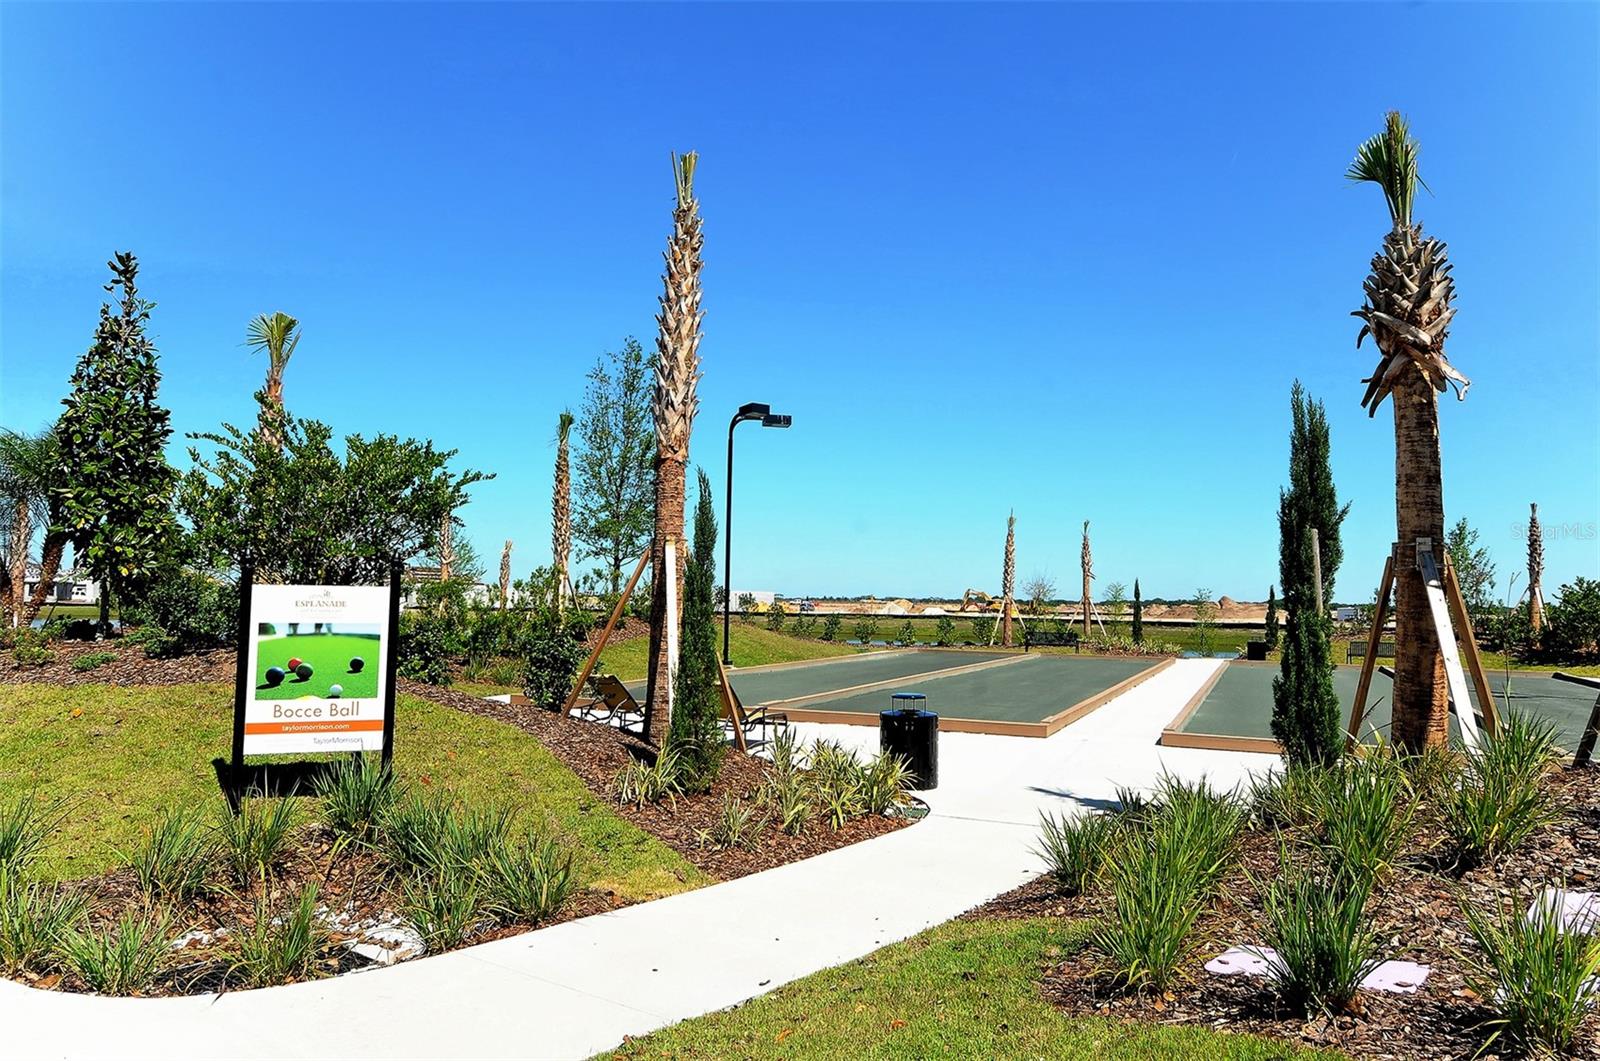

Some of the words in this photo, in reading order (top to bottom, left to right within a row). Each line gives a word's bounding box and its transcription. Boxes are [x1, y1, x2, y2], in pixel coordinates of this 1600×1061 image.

[295, 600, 347, 608] ESPLANADE
[273, 704, 322, 718] Bocce
[329, 701, 359, 716] Ball
[281, 724, 350, 732] taylormorrison.com
[313, 737, 362, 746] TaylorMorrison
